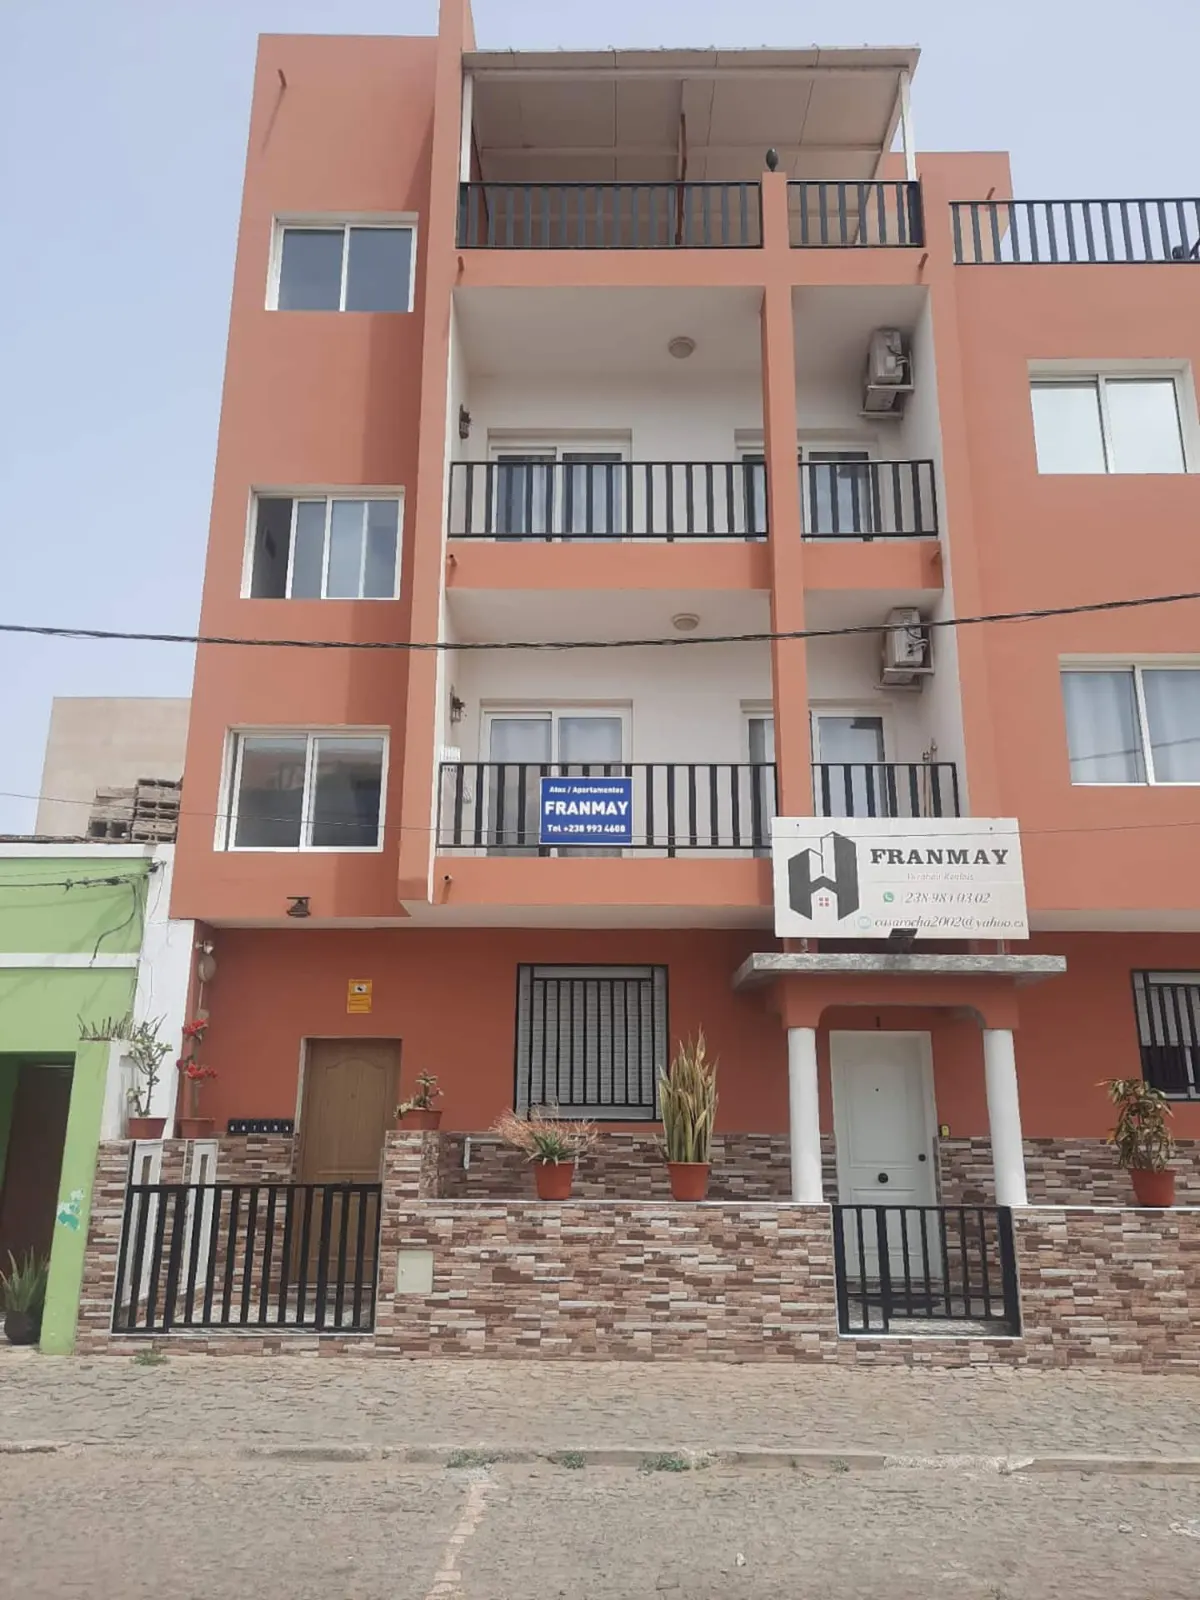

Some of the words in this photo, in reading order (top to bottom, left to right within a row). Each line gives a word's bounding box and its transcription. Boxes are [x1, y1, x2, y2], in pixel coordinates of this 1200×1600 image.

[545, 801, 628, 815] FRANMAY
[586, 824, 602, 832] 993
[870, 848, 1009, 865] FRANMAY
